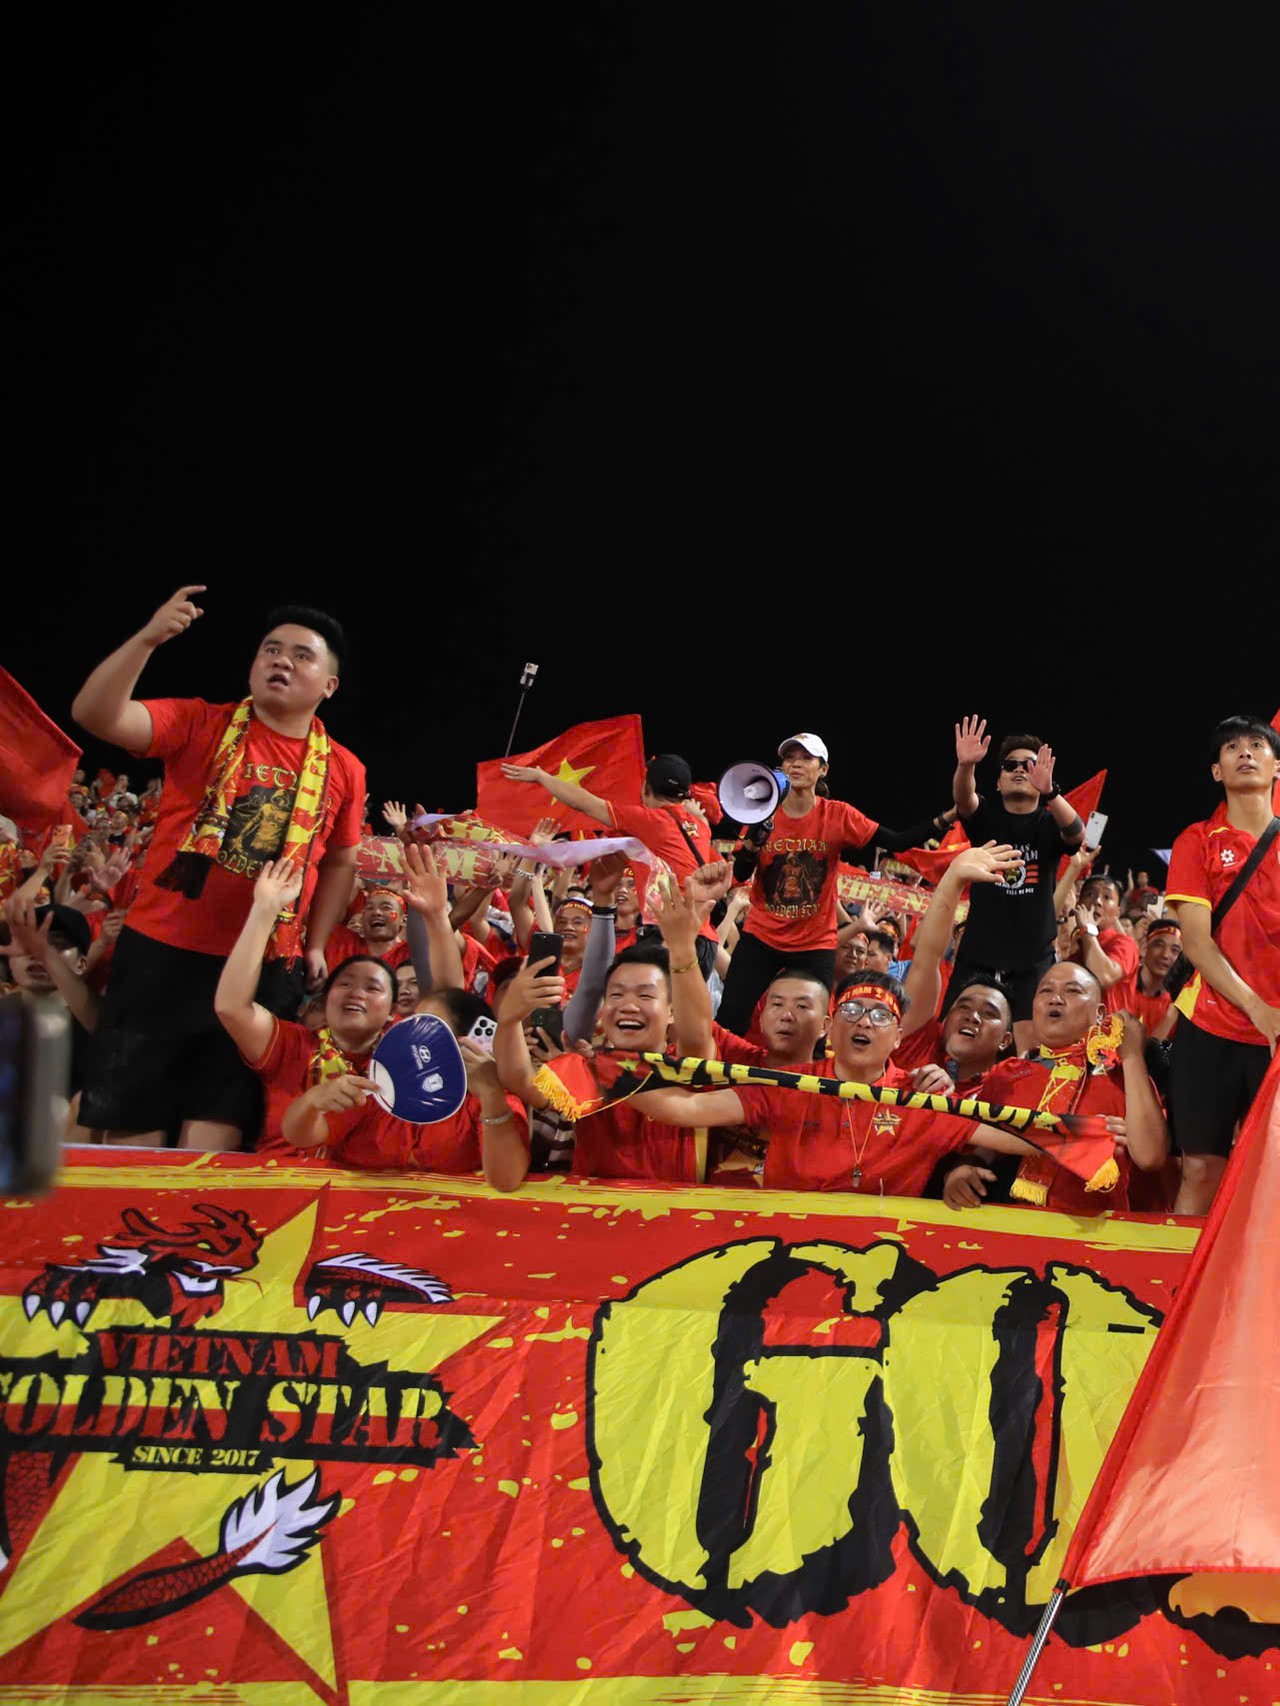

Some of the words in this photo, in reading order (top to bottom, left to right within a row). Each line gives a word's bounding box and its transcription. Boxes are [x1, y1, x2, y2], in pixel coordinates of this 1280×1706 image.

[97, 1331, 341, 1378] VIETNAM
[260, 1382, 443, 1449] STAR
[131, 1445, 202, 1465] SINCE
[211, 1449, 261, 1467] 2017
